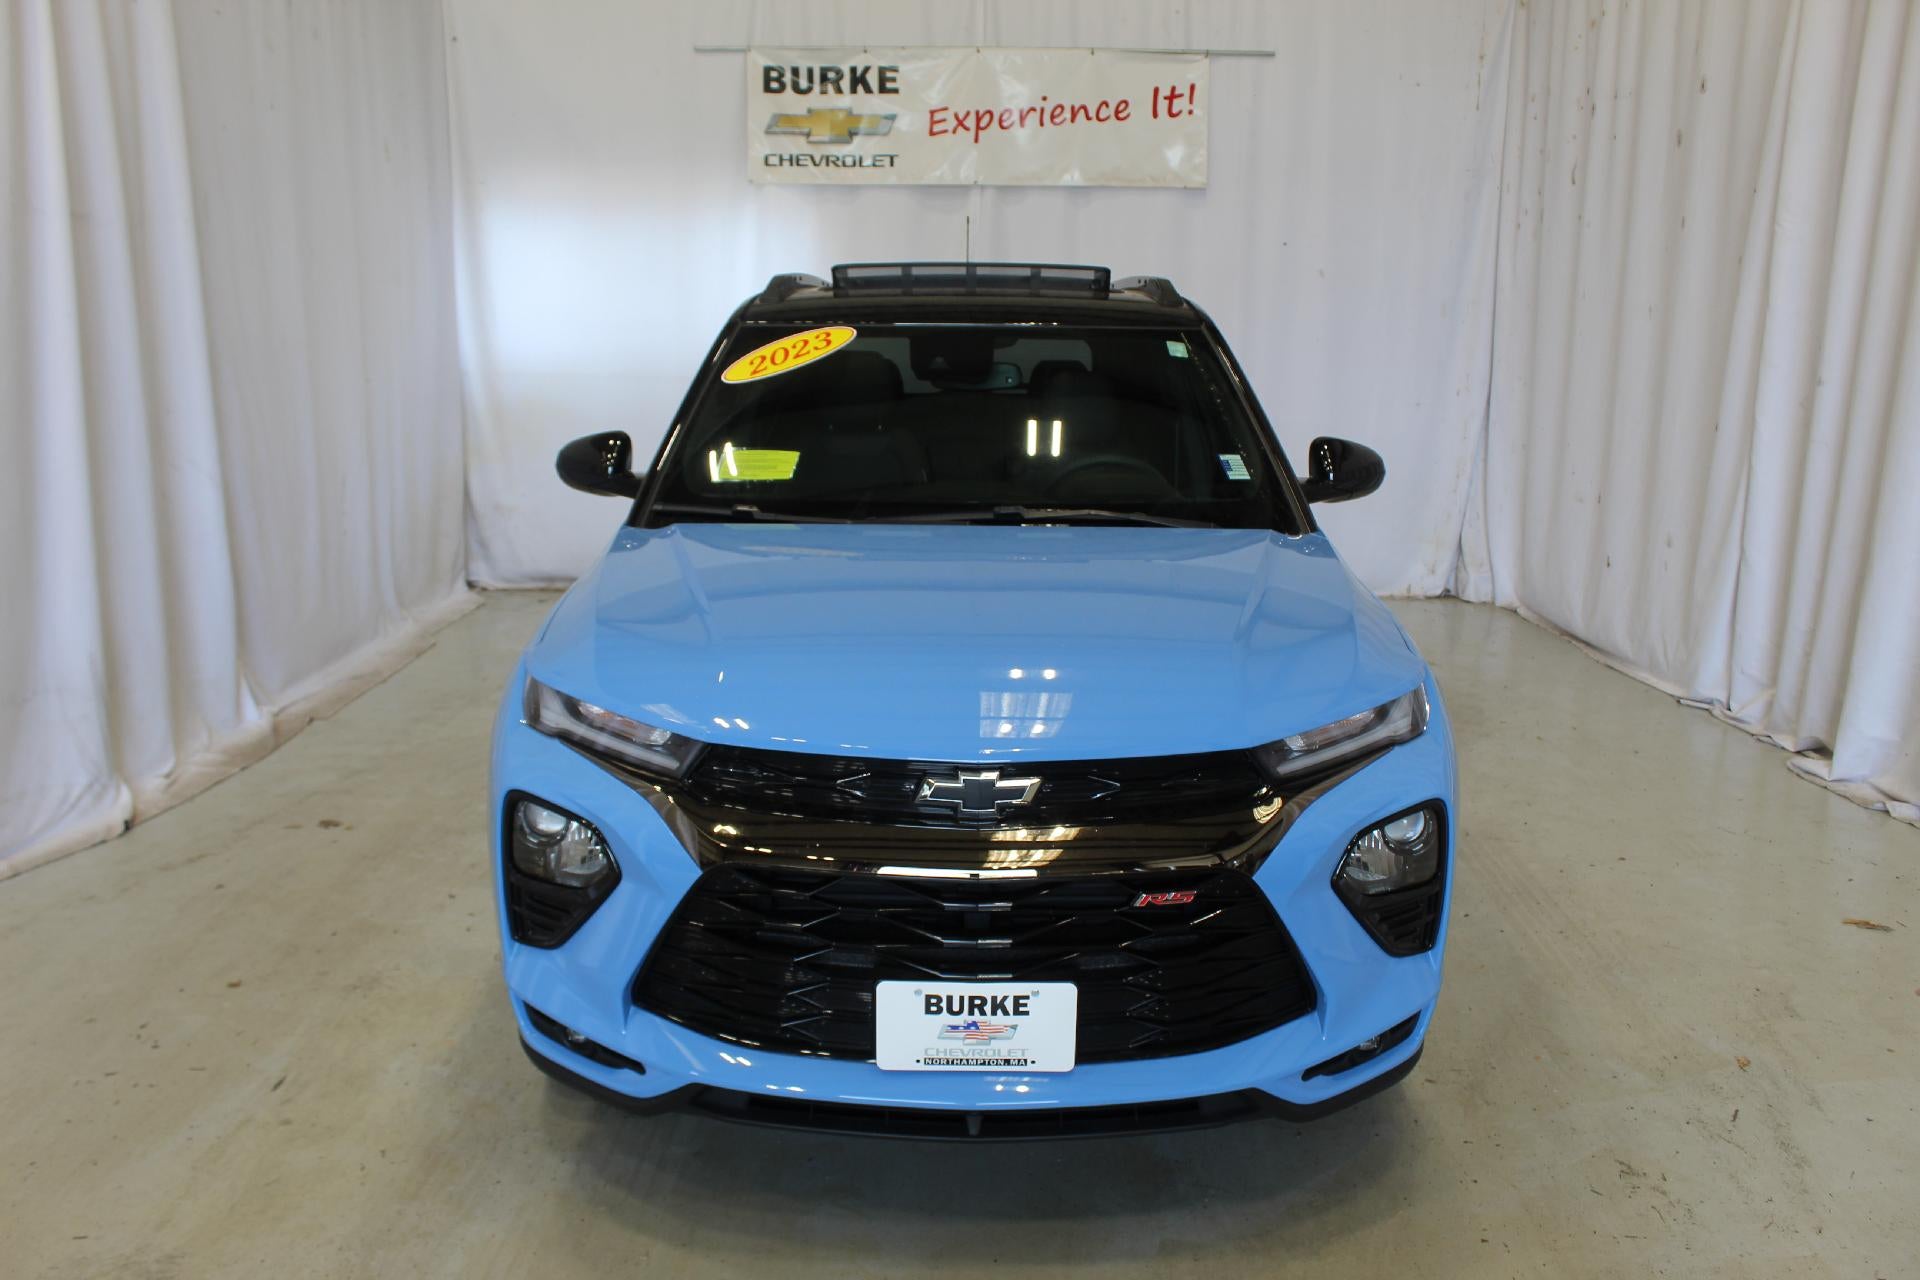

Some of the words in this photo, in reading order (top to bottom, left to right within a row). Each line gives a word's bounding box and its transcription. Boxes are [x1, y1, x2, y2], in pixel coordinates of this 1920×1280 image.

[763, 65, 900, 95] BURKE
[928, 95, 1131, 144] Experience
[1151, 83, 1197, 119] It!
[763, 152, 899, 169] CHEVROLET
[749, 331, 833, 376] 2023
[1133, 890, 1197, 907] RS
[924, 994, 1030, 1017] BURKE
[924, 1048, 1029, 1058] CHEVROLET
[1009, 1058, 1027, 1066] MA
